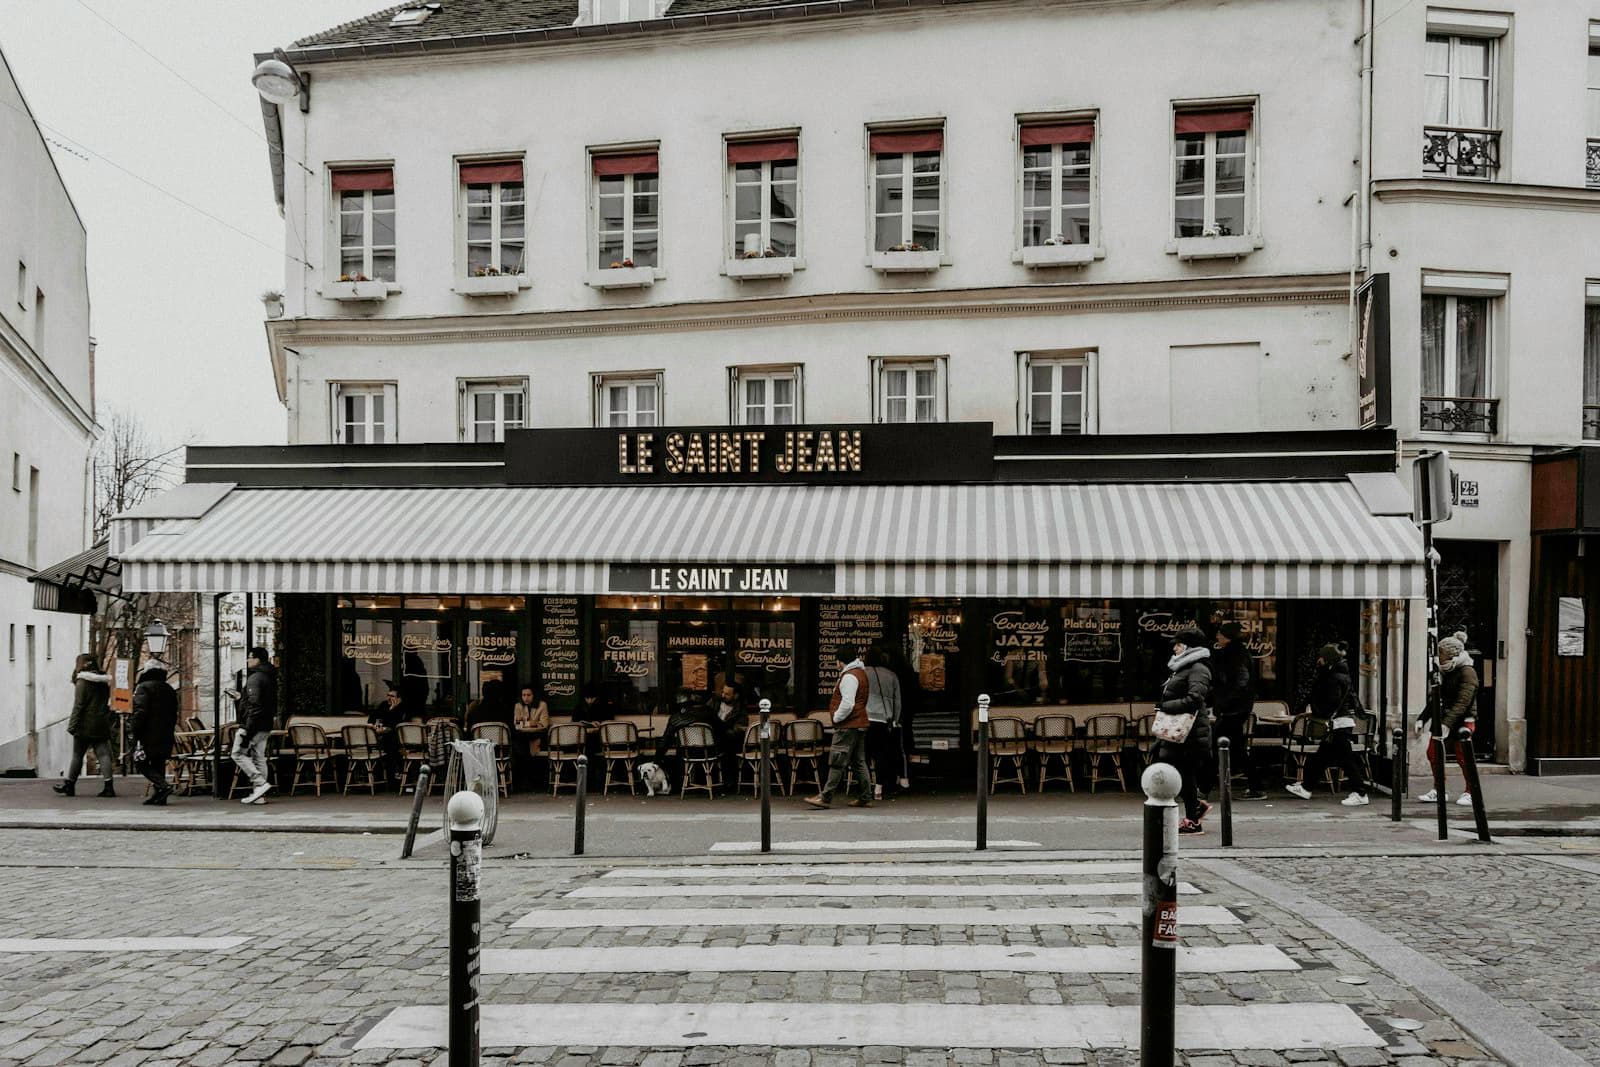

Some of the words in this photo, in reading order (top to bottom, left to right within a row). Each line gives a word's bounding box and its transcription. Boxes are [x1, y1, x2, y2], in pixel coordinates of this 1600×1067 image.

[618, 432, 654, 474] LE
[664, 431, 766, 474] SAINT
[775, 430, 862, 473] JEAN
[1462, 482, 1478, 495] 25
[650, 569, 671, 590] LE
[677, 568, 734, 590] SAINT
[739, 568, 789, 590] JEAN
[992, 611, 1050, 634] Concert
[1064, 618, 1084, 628] Plat
[1085, 618, 1097, 629] du
[1099, 618, 1121, 633] jour
[344, 635, 383, 645] PLANCHE
[467, 636, 516, 646] BOISSONS
[541, 638, 580, 646] COCKTAILS
[669, 637, 725, 646] HAMBURGER
[738, 638, 793, 649] TARTARE
[995, 634, 1045, 647] JAZZ
[468, 647, 516, 666] Chaudes
[603, 650, 655, 660] FERMIER
[738, 650, 793, 672] Charolais
[1027, 650, 1048, 661] 21h
